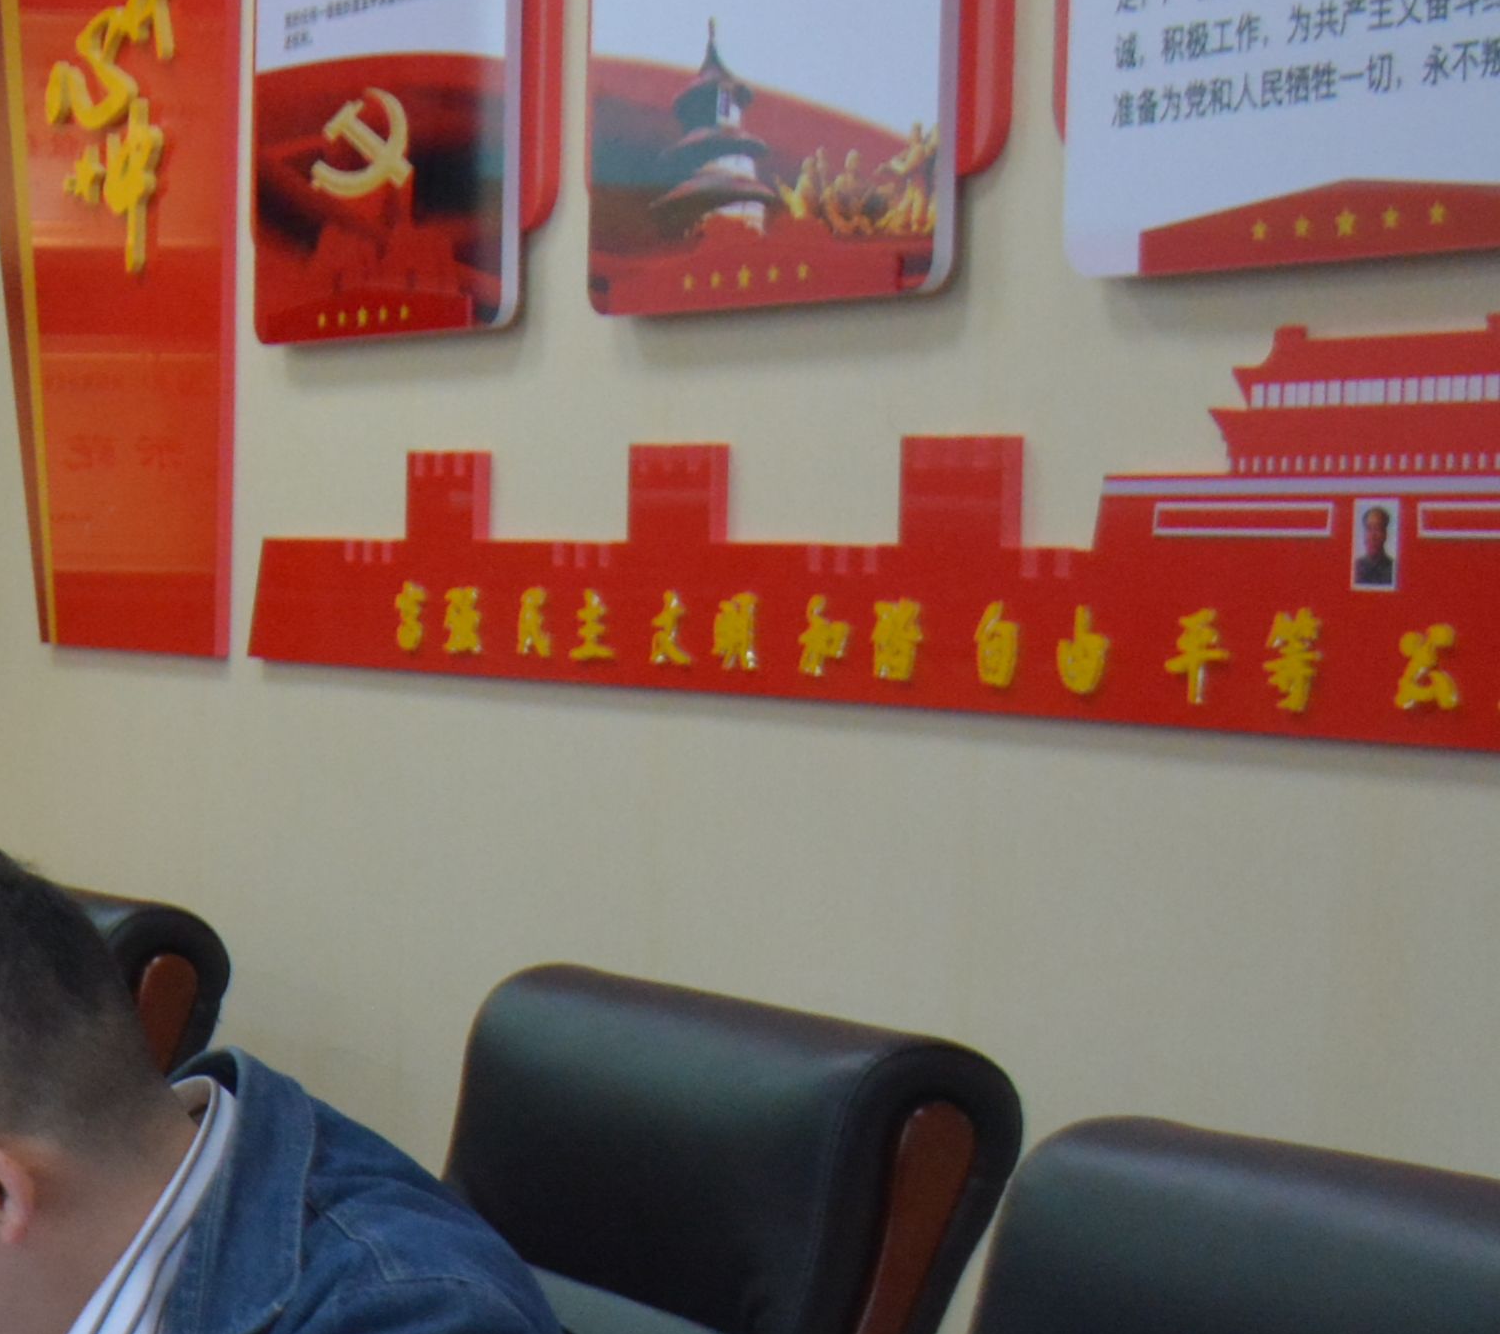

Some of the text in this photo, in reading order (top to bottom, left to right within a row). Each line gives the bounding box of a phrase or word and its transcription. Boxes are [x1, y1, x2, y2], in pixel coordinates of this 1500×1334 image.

[394, 581, 484, 655] 富强
[515, 586, 615, 662] 民主
[650, 590, 758, 670] 文明
[797, 594, 921, 683] 和谐
[973, 600, 1110, 695] 自由
[1164, 607, 1324, 713] 平等
